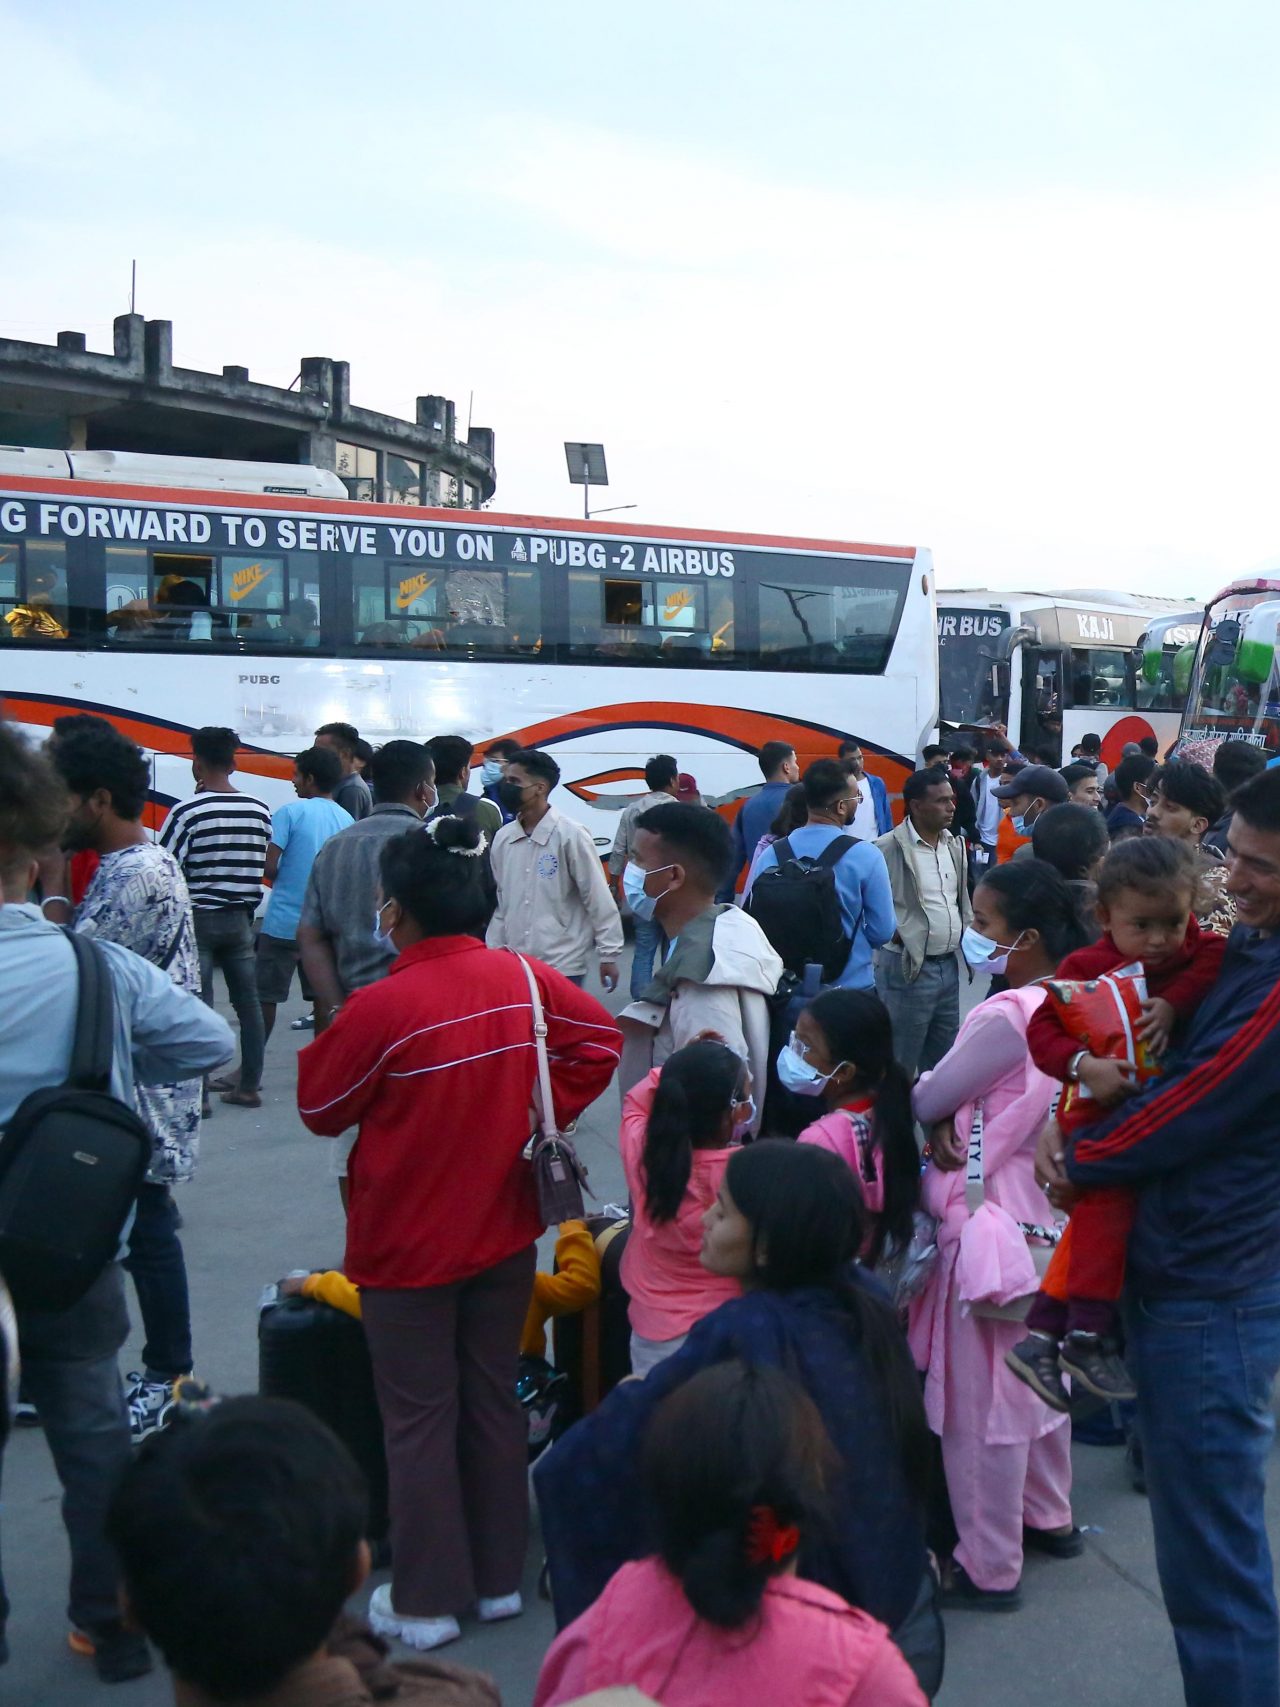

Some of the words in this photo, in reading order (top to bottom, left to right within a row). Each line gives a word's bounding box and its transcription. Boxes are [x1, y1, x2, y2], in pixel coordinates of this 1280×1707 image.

[40, 503, 212, 543] FORWARD
[221, 516, 267, 548] TO
[277, 519, 377, 555] SERVE
[389, 527, 445, 558] YOU
[456, 533, 494, 561] ON
[530, 537, 607, 569] PUBG
[642, 547, 735, 577] AIRBUS
[233, 563, 263, 586] NIKE
[400, 572, 427, 595] NIKE
[960, 615, 1002, 636] BUS
[1077, 614, 1114, 640] KAJI
[239, 675, 280, 684] PUBG
